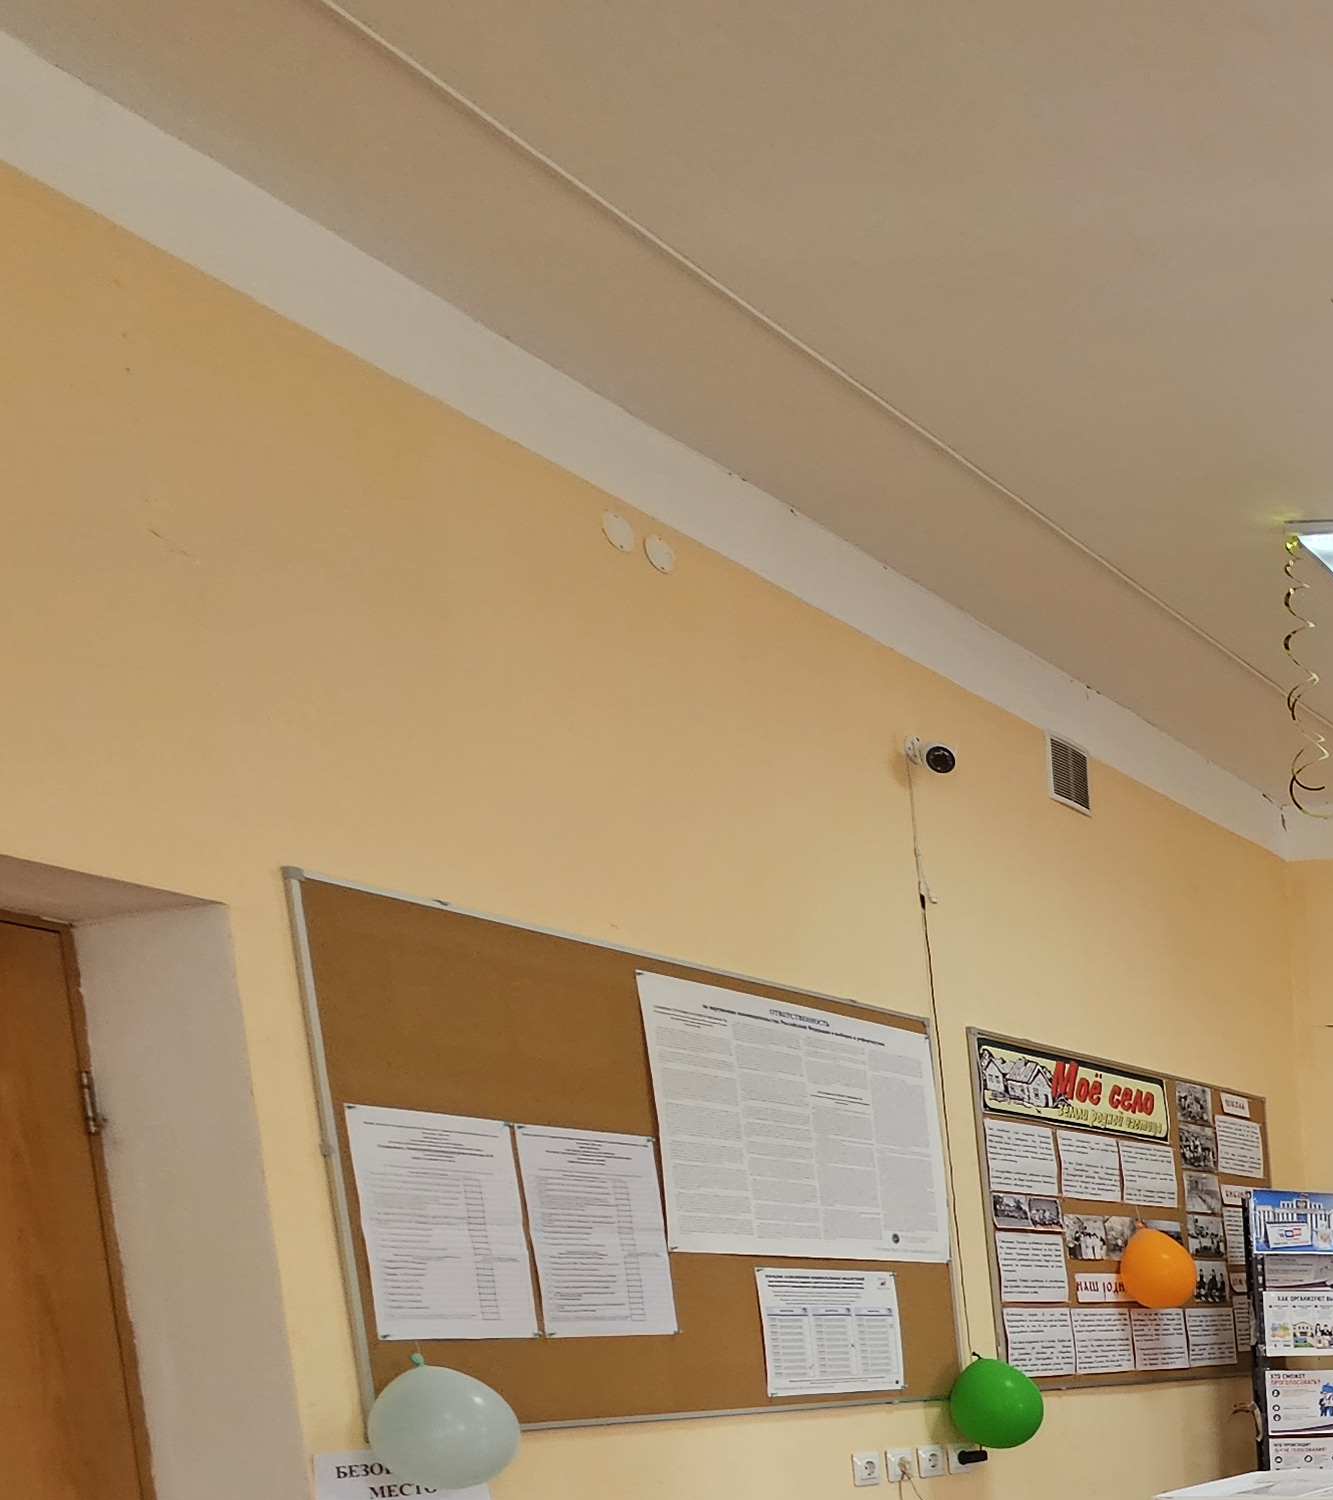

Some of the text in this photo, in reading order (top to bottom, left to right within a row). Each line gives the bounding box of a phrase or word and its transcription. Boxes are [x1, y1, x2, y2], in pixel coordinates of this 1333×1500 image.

[1052, 1061, 1155, 1116] Моё село
[1089, 1109, 1124, 1129] родной
[1126, 1116, 1163, 1137] частица
[1076, 1281, 1125, 1301] НАШ РОДН
